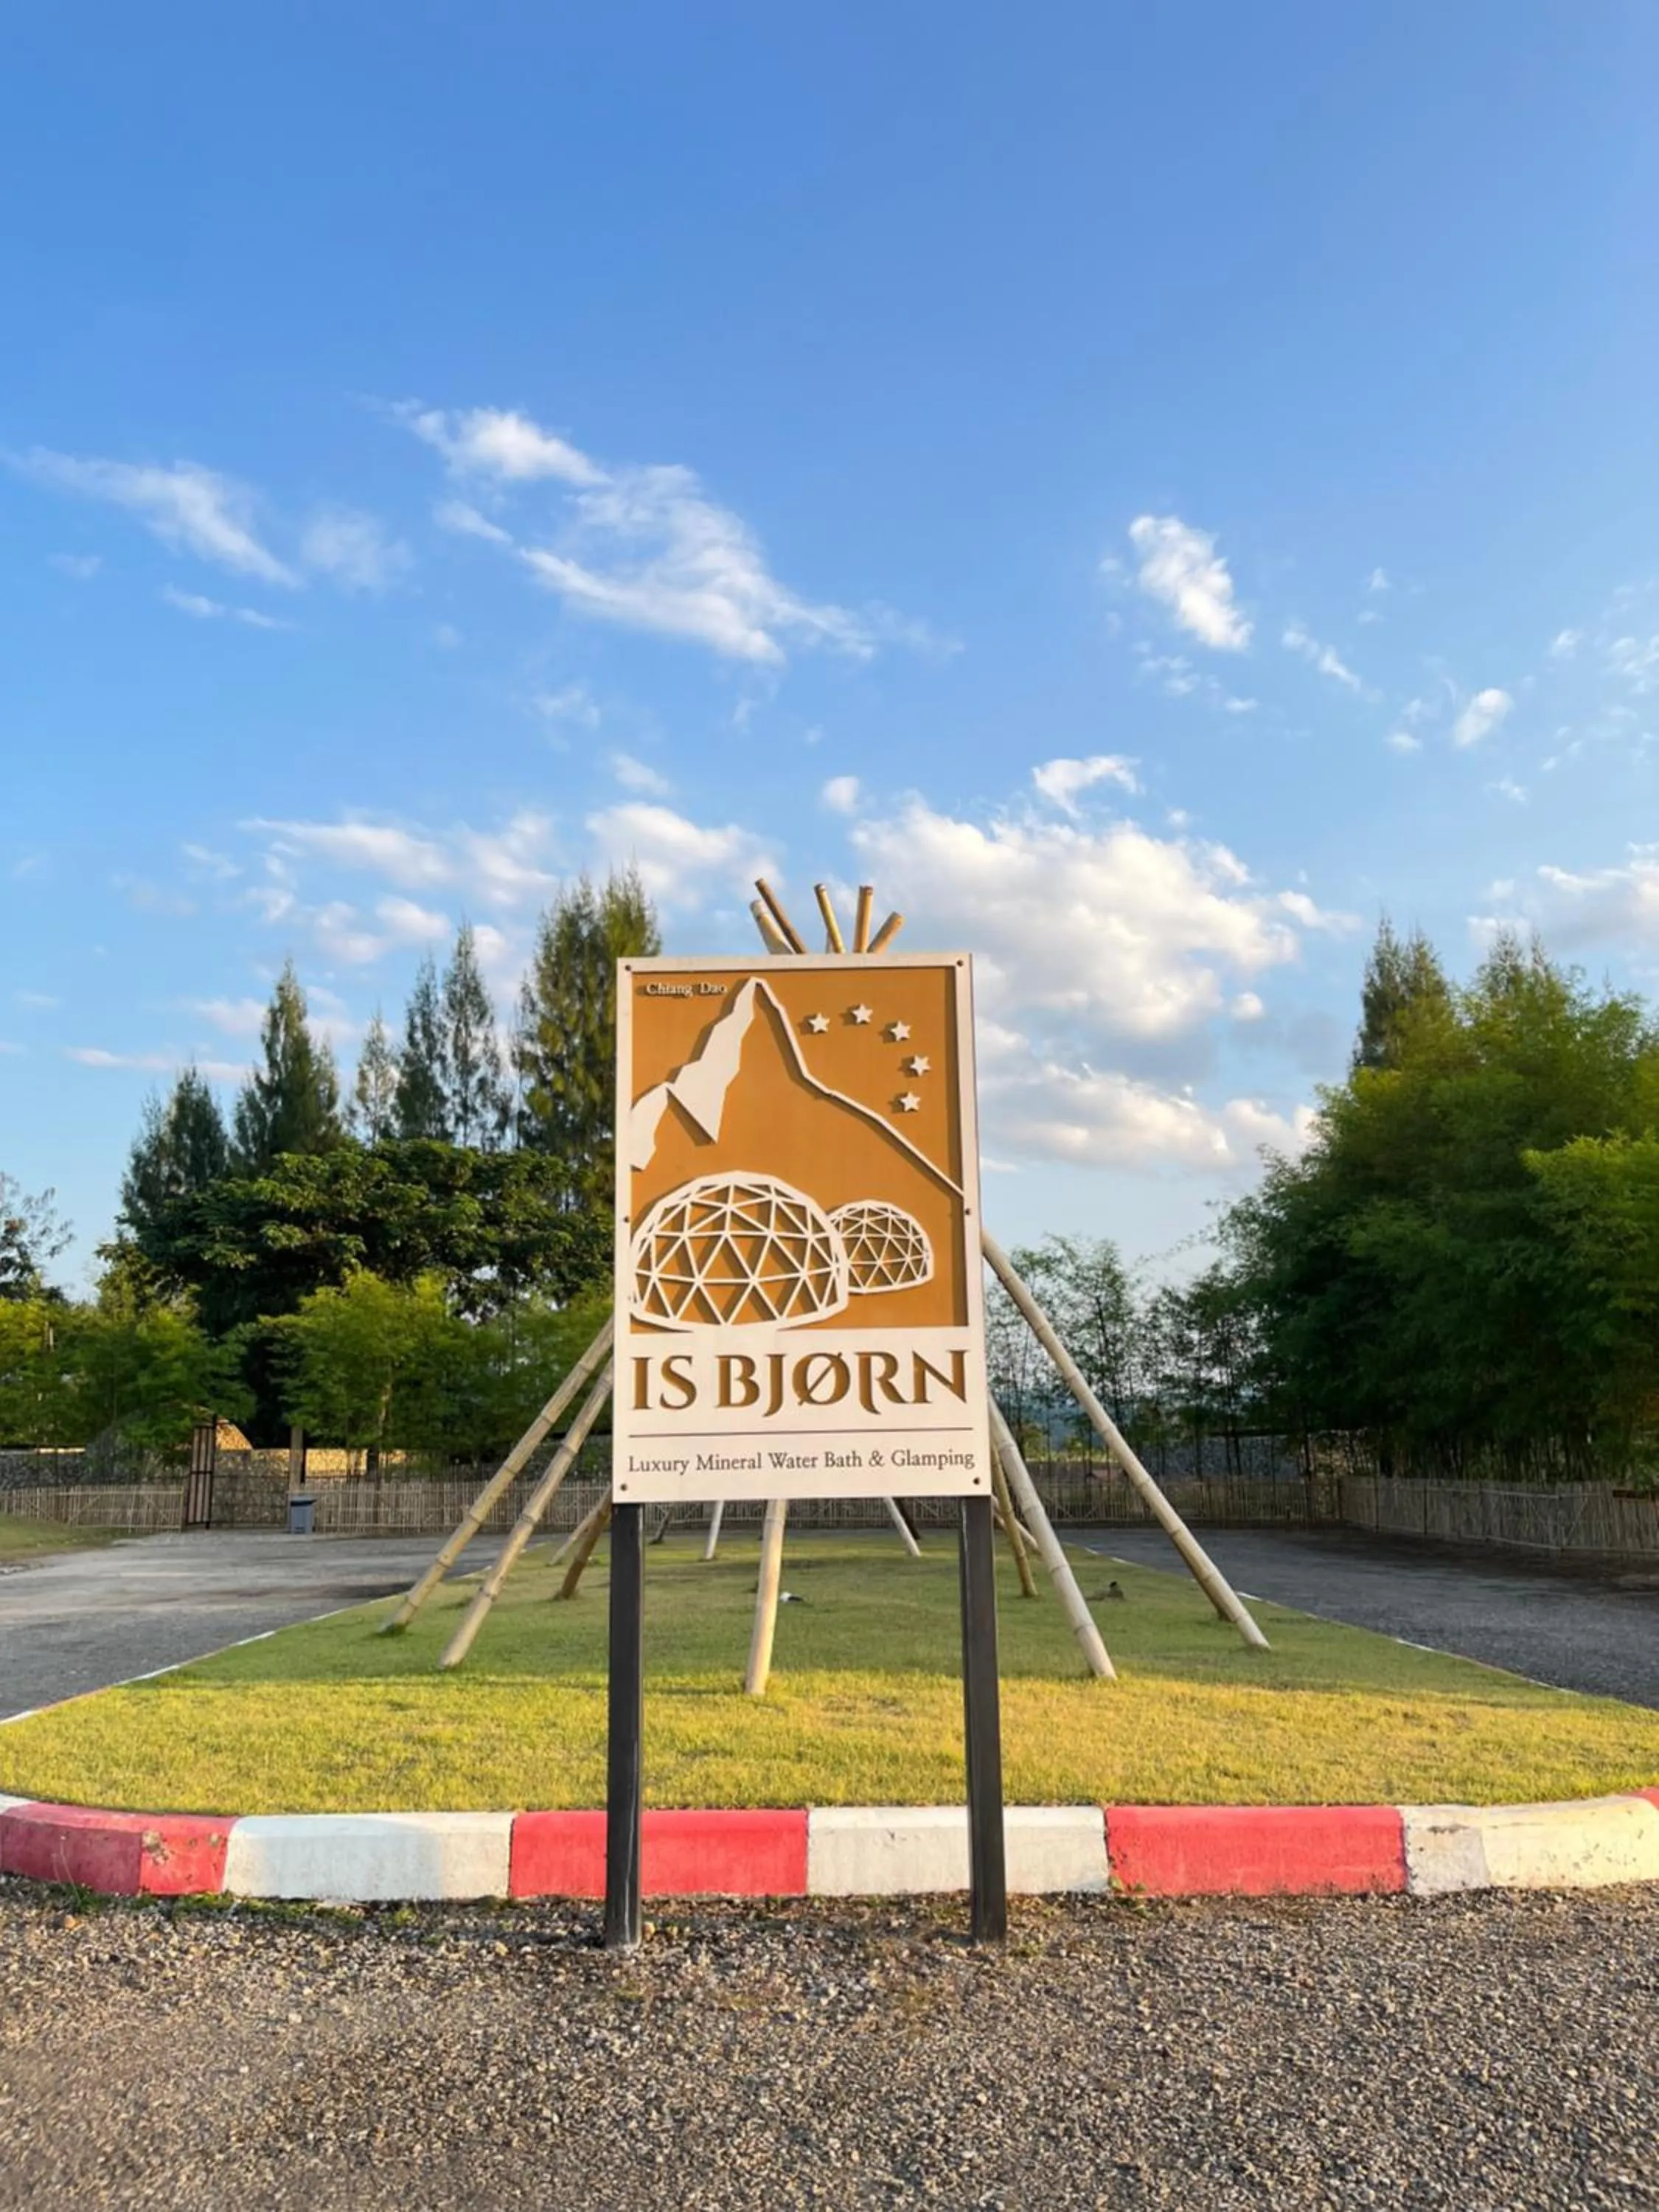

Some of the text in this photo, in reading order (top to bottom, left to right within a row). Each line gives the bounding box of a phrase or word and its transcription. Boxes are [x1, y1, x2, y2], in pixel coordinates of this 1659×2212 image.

[647, 981, 728, 997] Chiang Dao
[631, 1349, 969, 1417] IS BJØRN
[628, 1448, 975, 1475] Luxury Mineral Water Bath & Glamping
